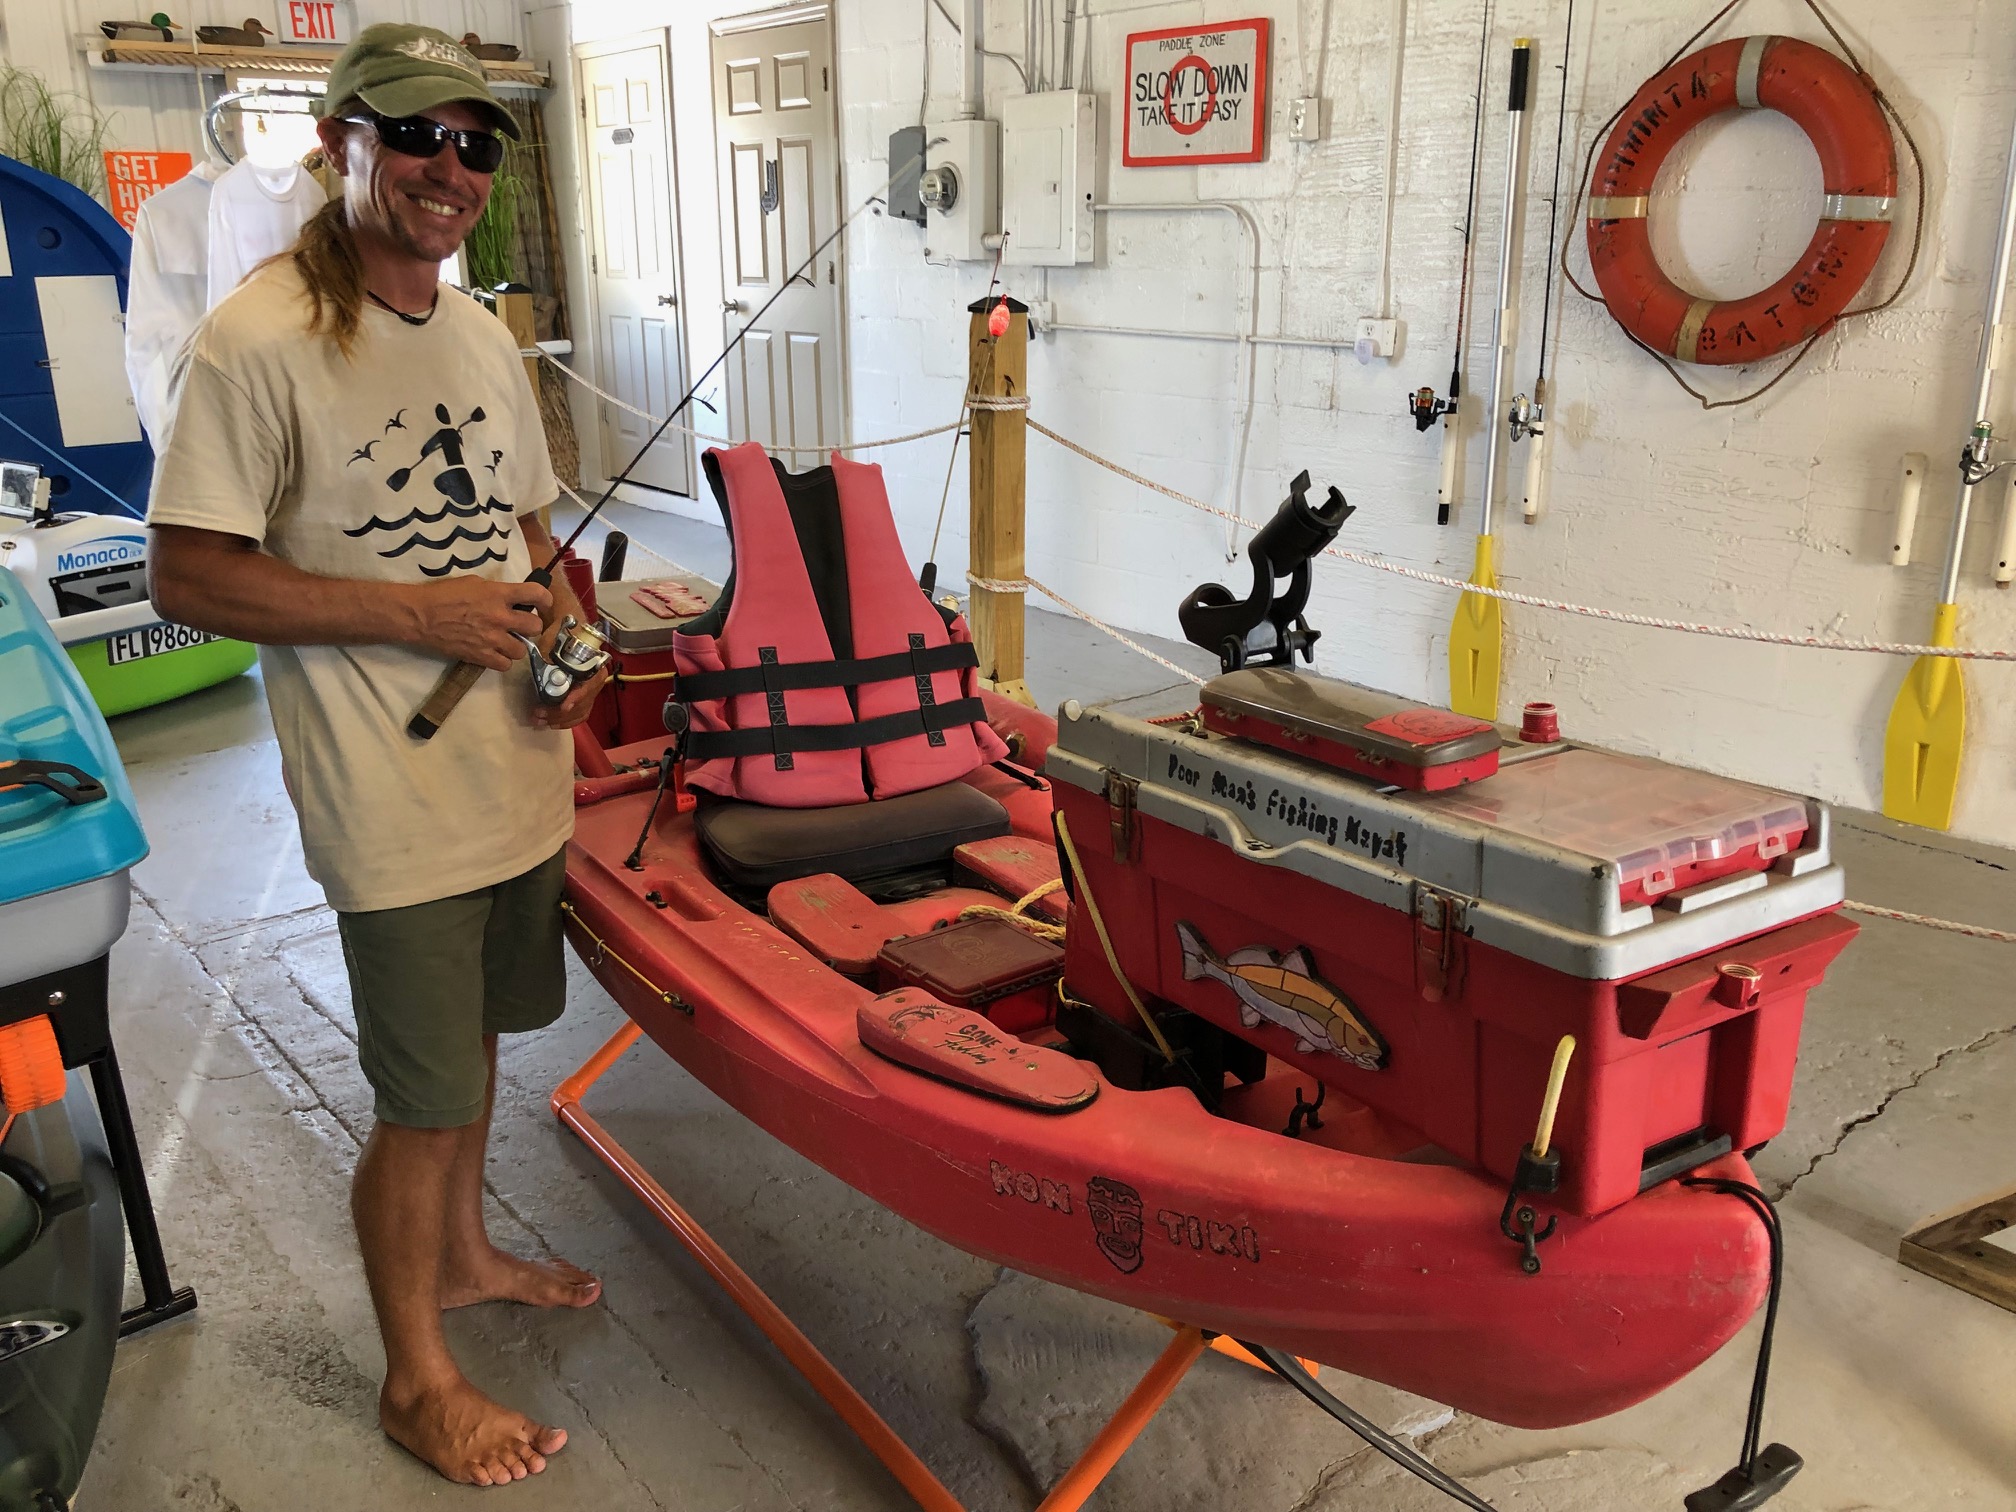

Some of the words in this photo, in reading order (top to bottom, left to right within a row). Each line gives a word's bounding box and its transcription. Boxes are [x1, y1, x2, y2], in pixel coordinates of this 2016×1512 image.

[289, 1, 336, 39] EXIT
[1159, 37, 1193, 52] PADDLE
[1199, 33, 1227, 48] ZONE
[1135, 68, 1186, 102] SLOW
[1194, 62, 1248, 98] DOWN
[1137, 103, 1178, 126] TAKE
[1182, 102, 1196, 124] IT
[1200, 98, 1242, 123] EASY
[113, 154, 159, 181] GET
[57, 546, 128, 572] Monaco
[116, 633, 140, 661] FL
[1168, 753, 1200, 787] Poor
[959, 1024, 1003, 1048] GONE
[989, 1159, 1073, 1215] KON
[1157, 1208, 1260, 1263] TIKI
